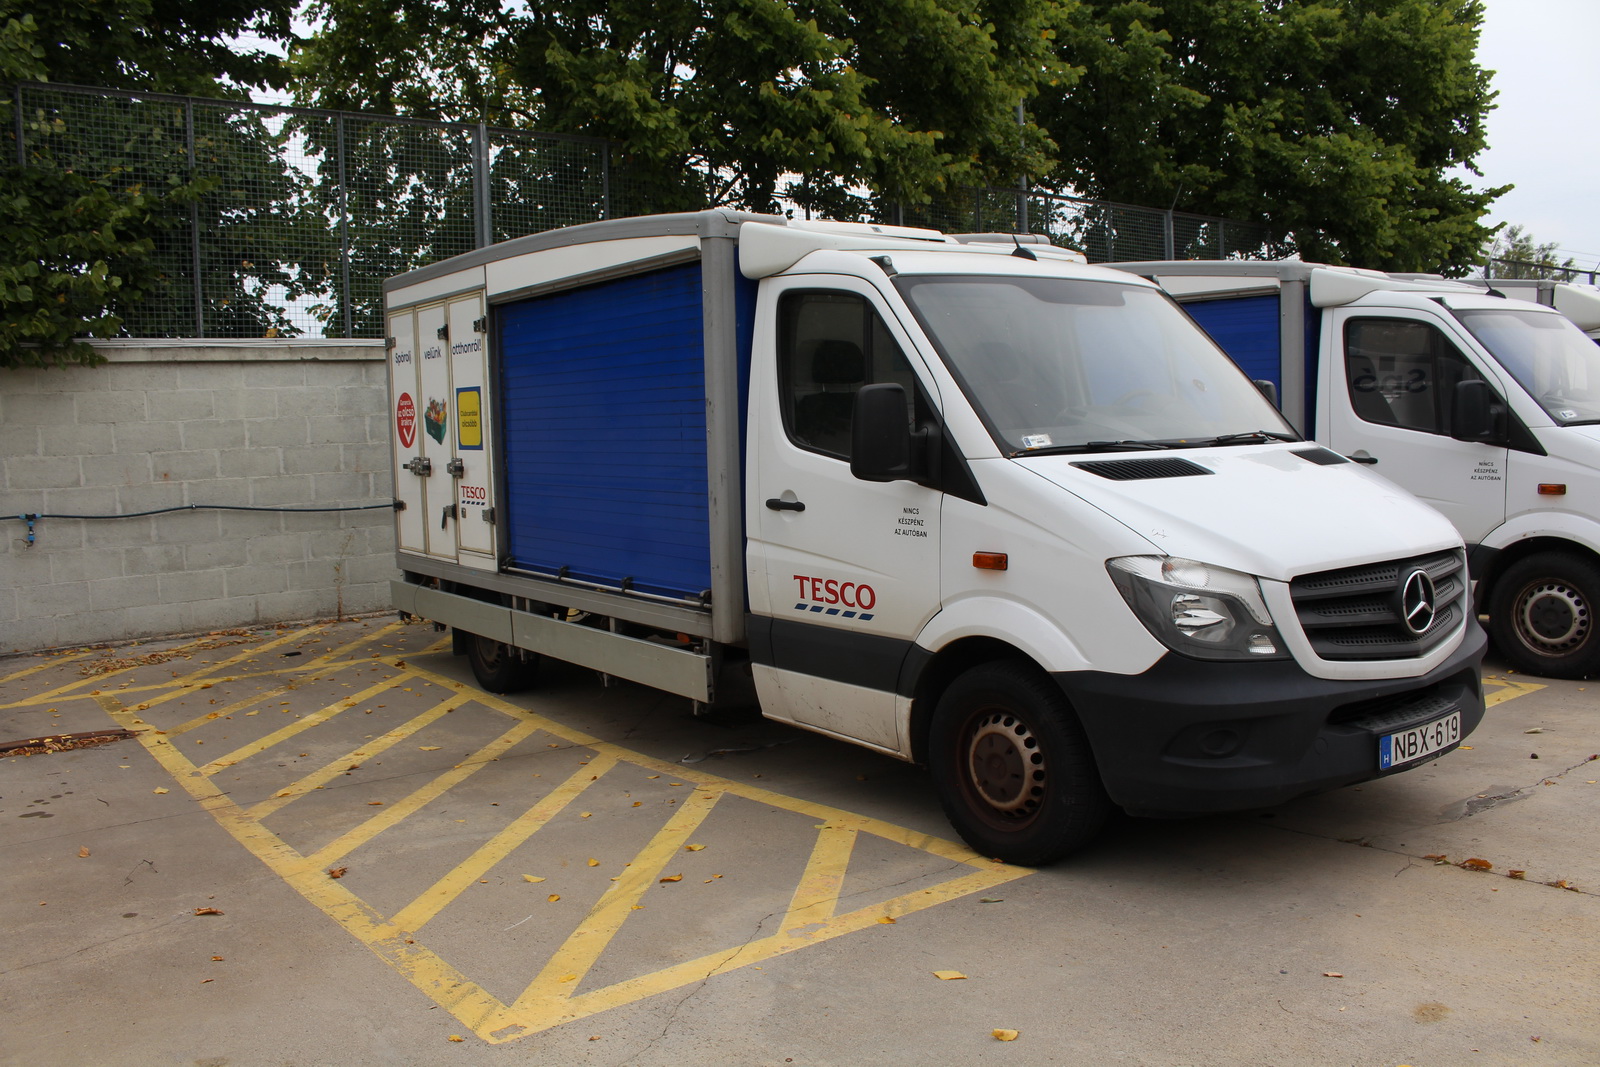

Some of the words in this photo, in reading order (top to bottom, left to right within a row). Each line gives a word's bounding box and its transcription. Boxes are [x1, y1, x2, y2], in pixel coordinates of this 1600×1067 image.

[424, 346, 442, 360] velünk
[452, 339, 482, 356] otthonról!
[460, 485, 486, 500] TESCO
[903, 507, 920, 515] NINCS
[898, 517, 924, 527] KÉSZPÉNZ
[902, 528, 928, 538] AUTÓBAN
[793, 575, 876, 610] TESCO
[1383, 753, 1390, 764] H
[1394, 716, 1458, 761] NBX-619
